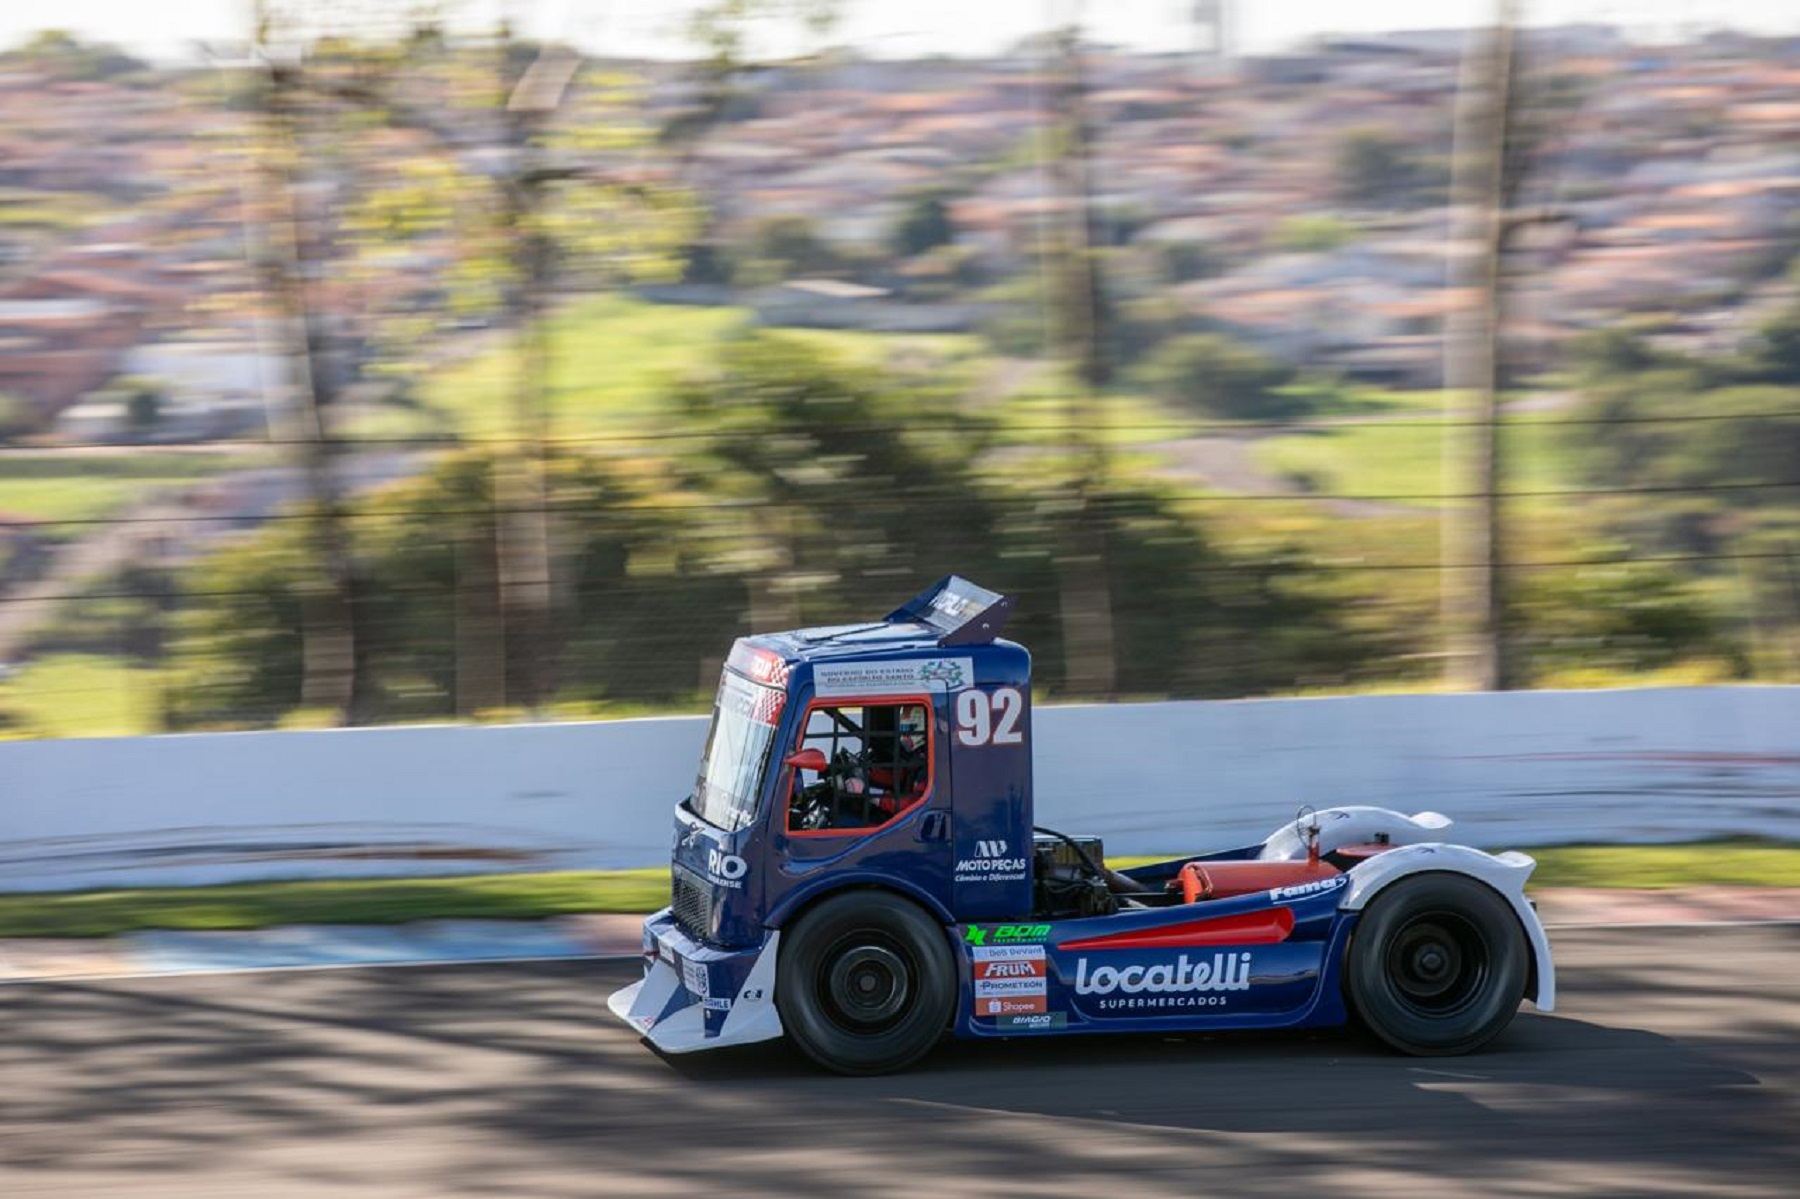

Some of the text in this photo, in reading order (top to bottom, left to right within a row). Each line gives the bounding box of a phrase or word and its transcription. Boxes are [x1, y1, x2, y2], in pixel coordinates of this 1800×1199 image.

[957, 687, 1022, 746] 92
[708, 848, 747, 880] RIO
[1270, 878, 1337, 901] Fama
[984, 961, 1036, 977] FRUM
[1002, 1001, 1036, 1012] Shopee
[1100, 996, 1228, 1009] SUPERMERCADOS
[1012, 1015, 1051, 1024] BIAGIO
